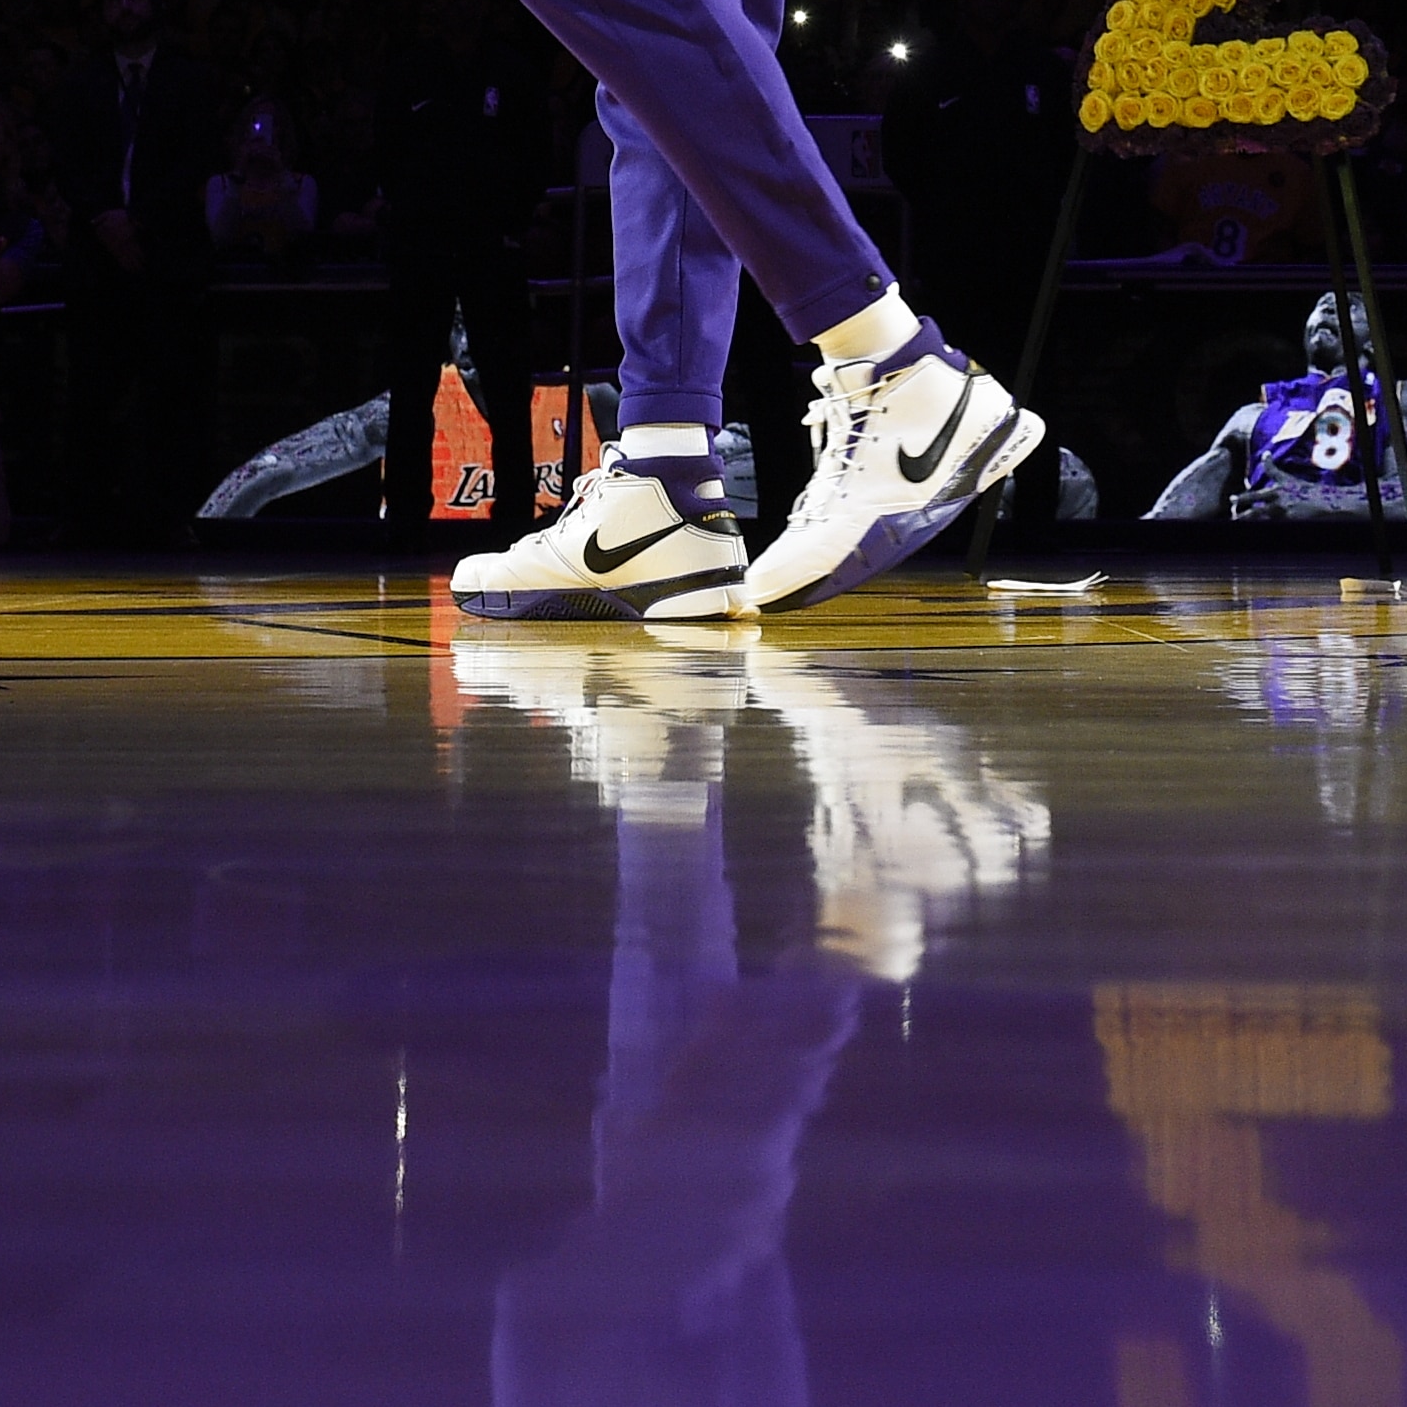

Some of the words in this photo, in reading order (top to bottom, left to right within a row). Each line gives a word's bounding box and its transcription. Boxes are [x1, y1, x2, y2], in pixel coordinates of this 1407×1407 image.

[1197, 180, 1280, 220] BRYANT
[1212, 216, 1247, 261] 8
[1310, 409, 1355, 471] 8
[446, 460, 564, 511] LARS
